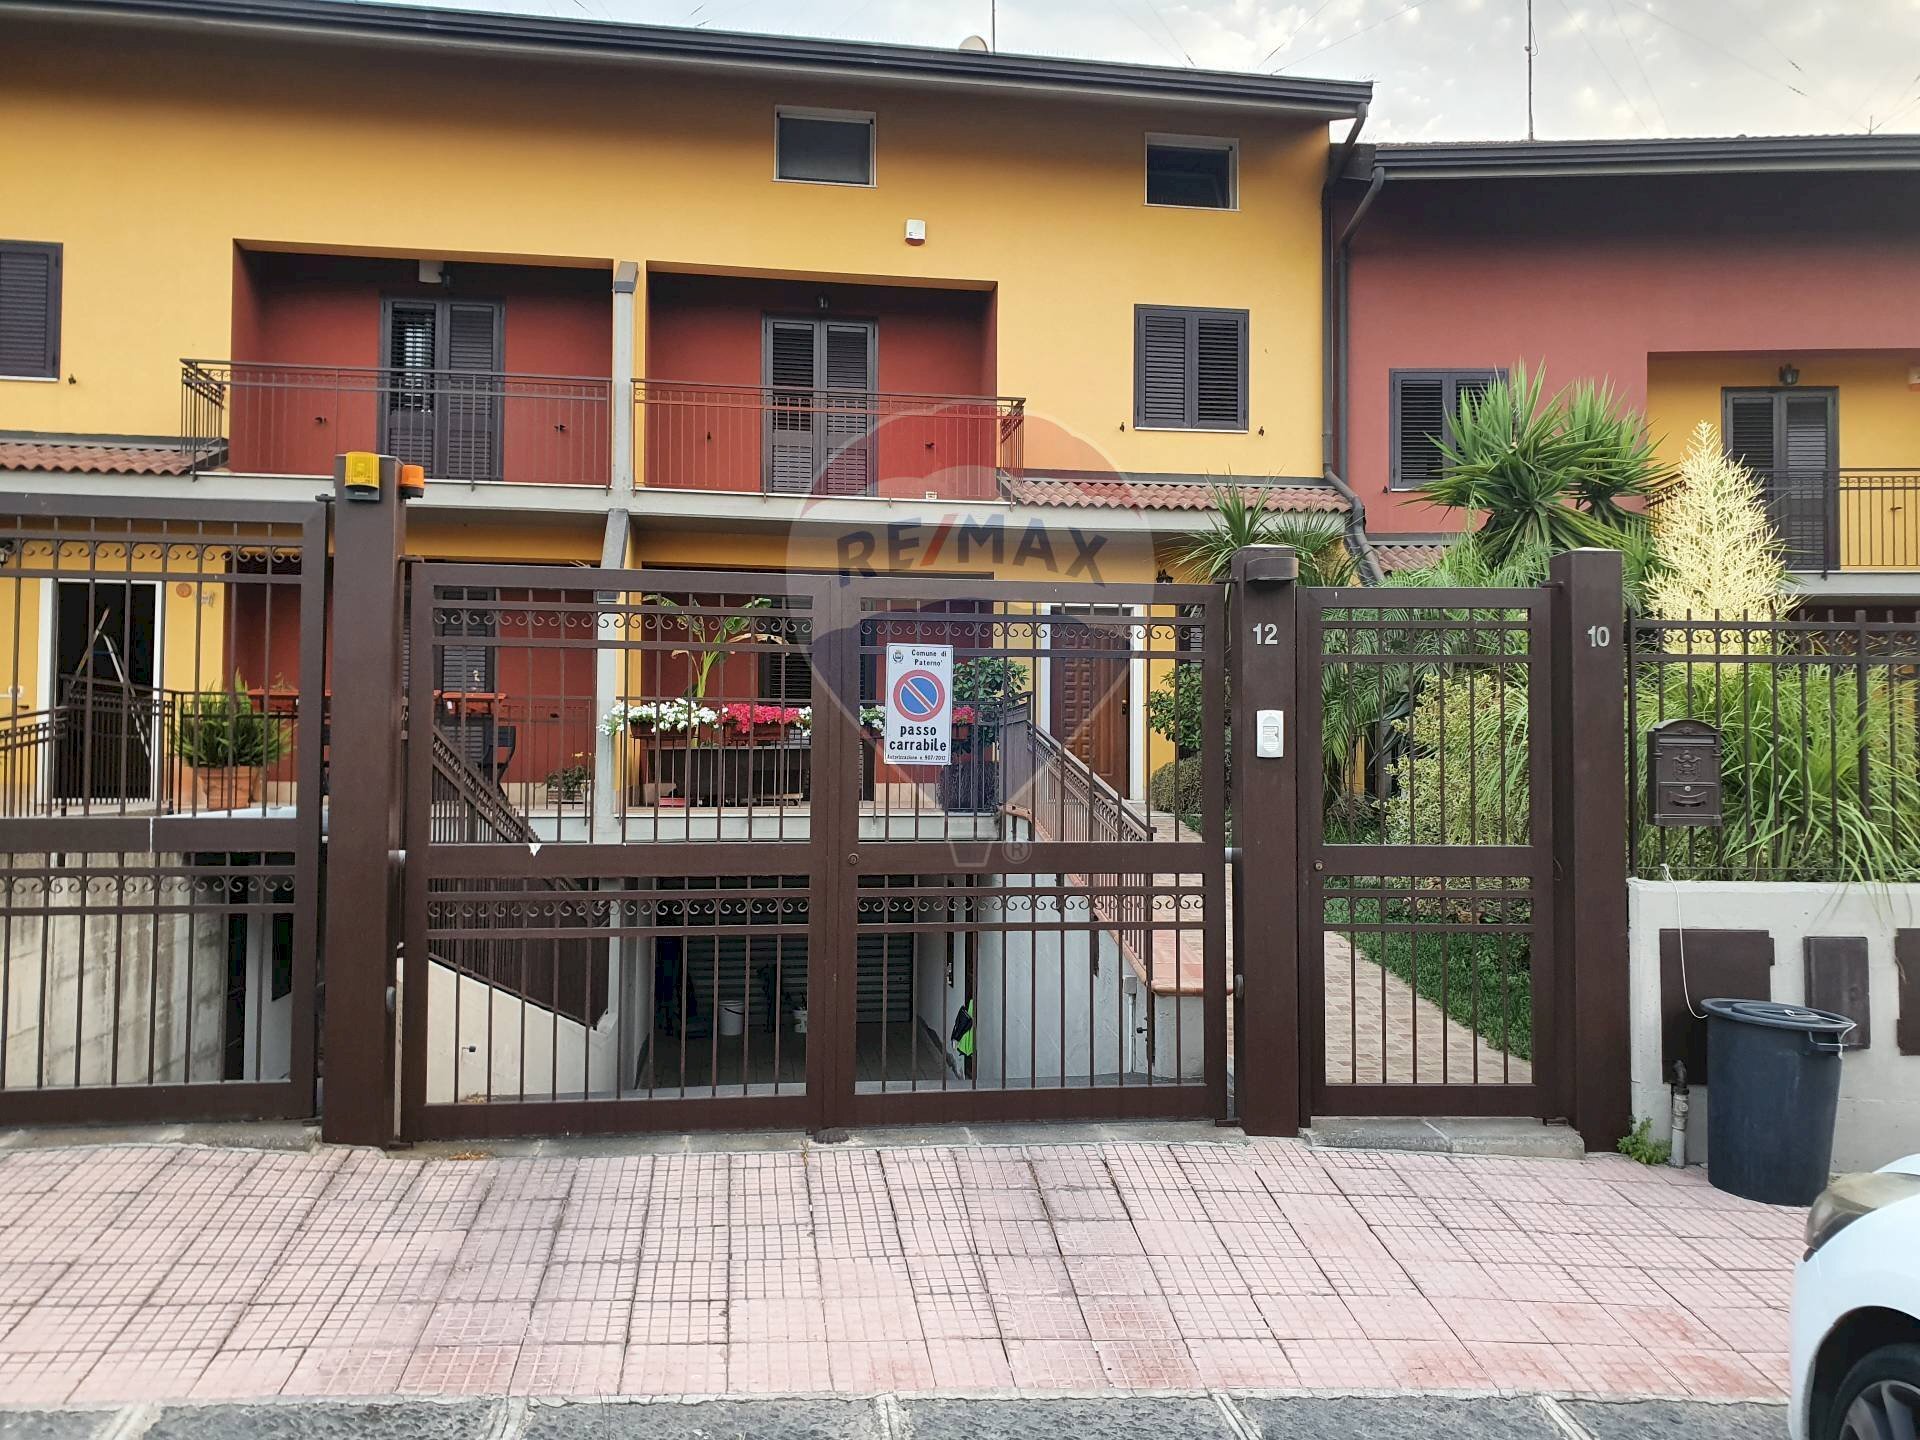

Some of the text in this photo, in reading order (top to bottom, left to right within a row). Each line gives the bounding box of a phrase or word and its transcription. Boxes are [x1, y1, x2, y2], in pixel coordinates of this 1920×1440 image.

[1252, 622, 1278, 645] 12
[1587, 625, 1610, 648] 10
[911, 648, 937, 657] Comune
[900, 725, 937, 738] passo
[889, 737, 947, 751] carrabile
